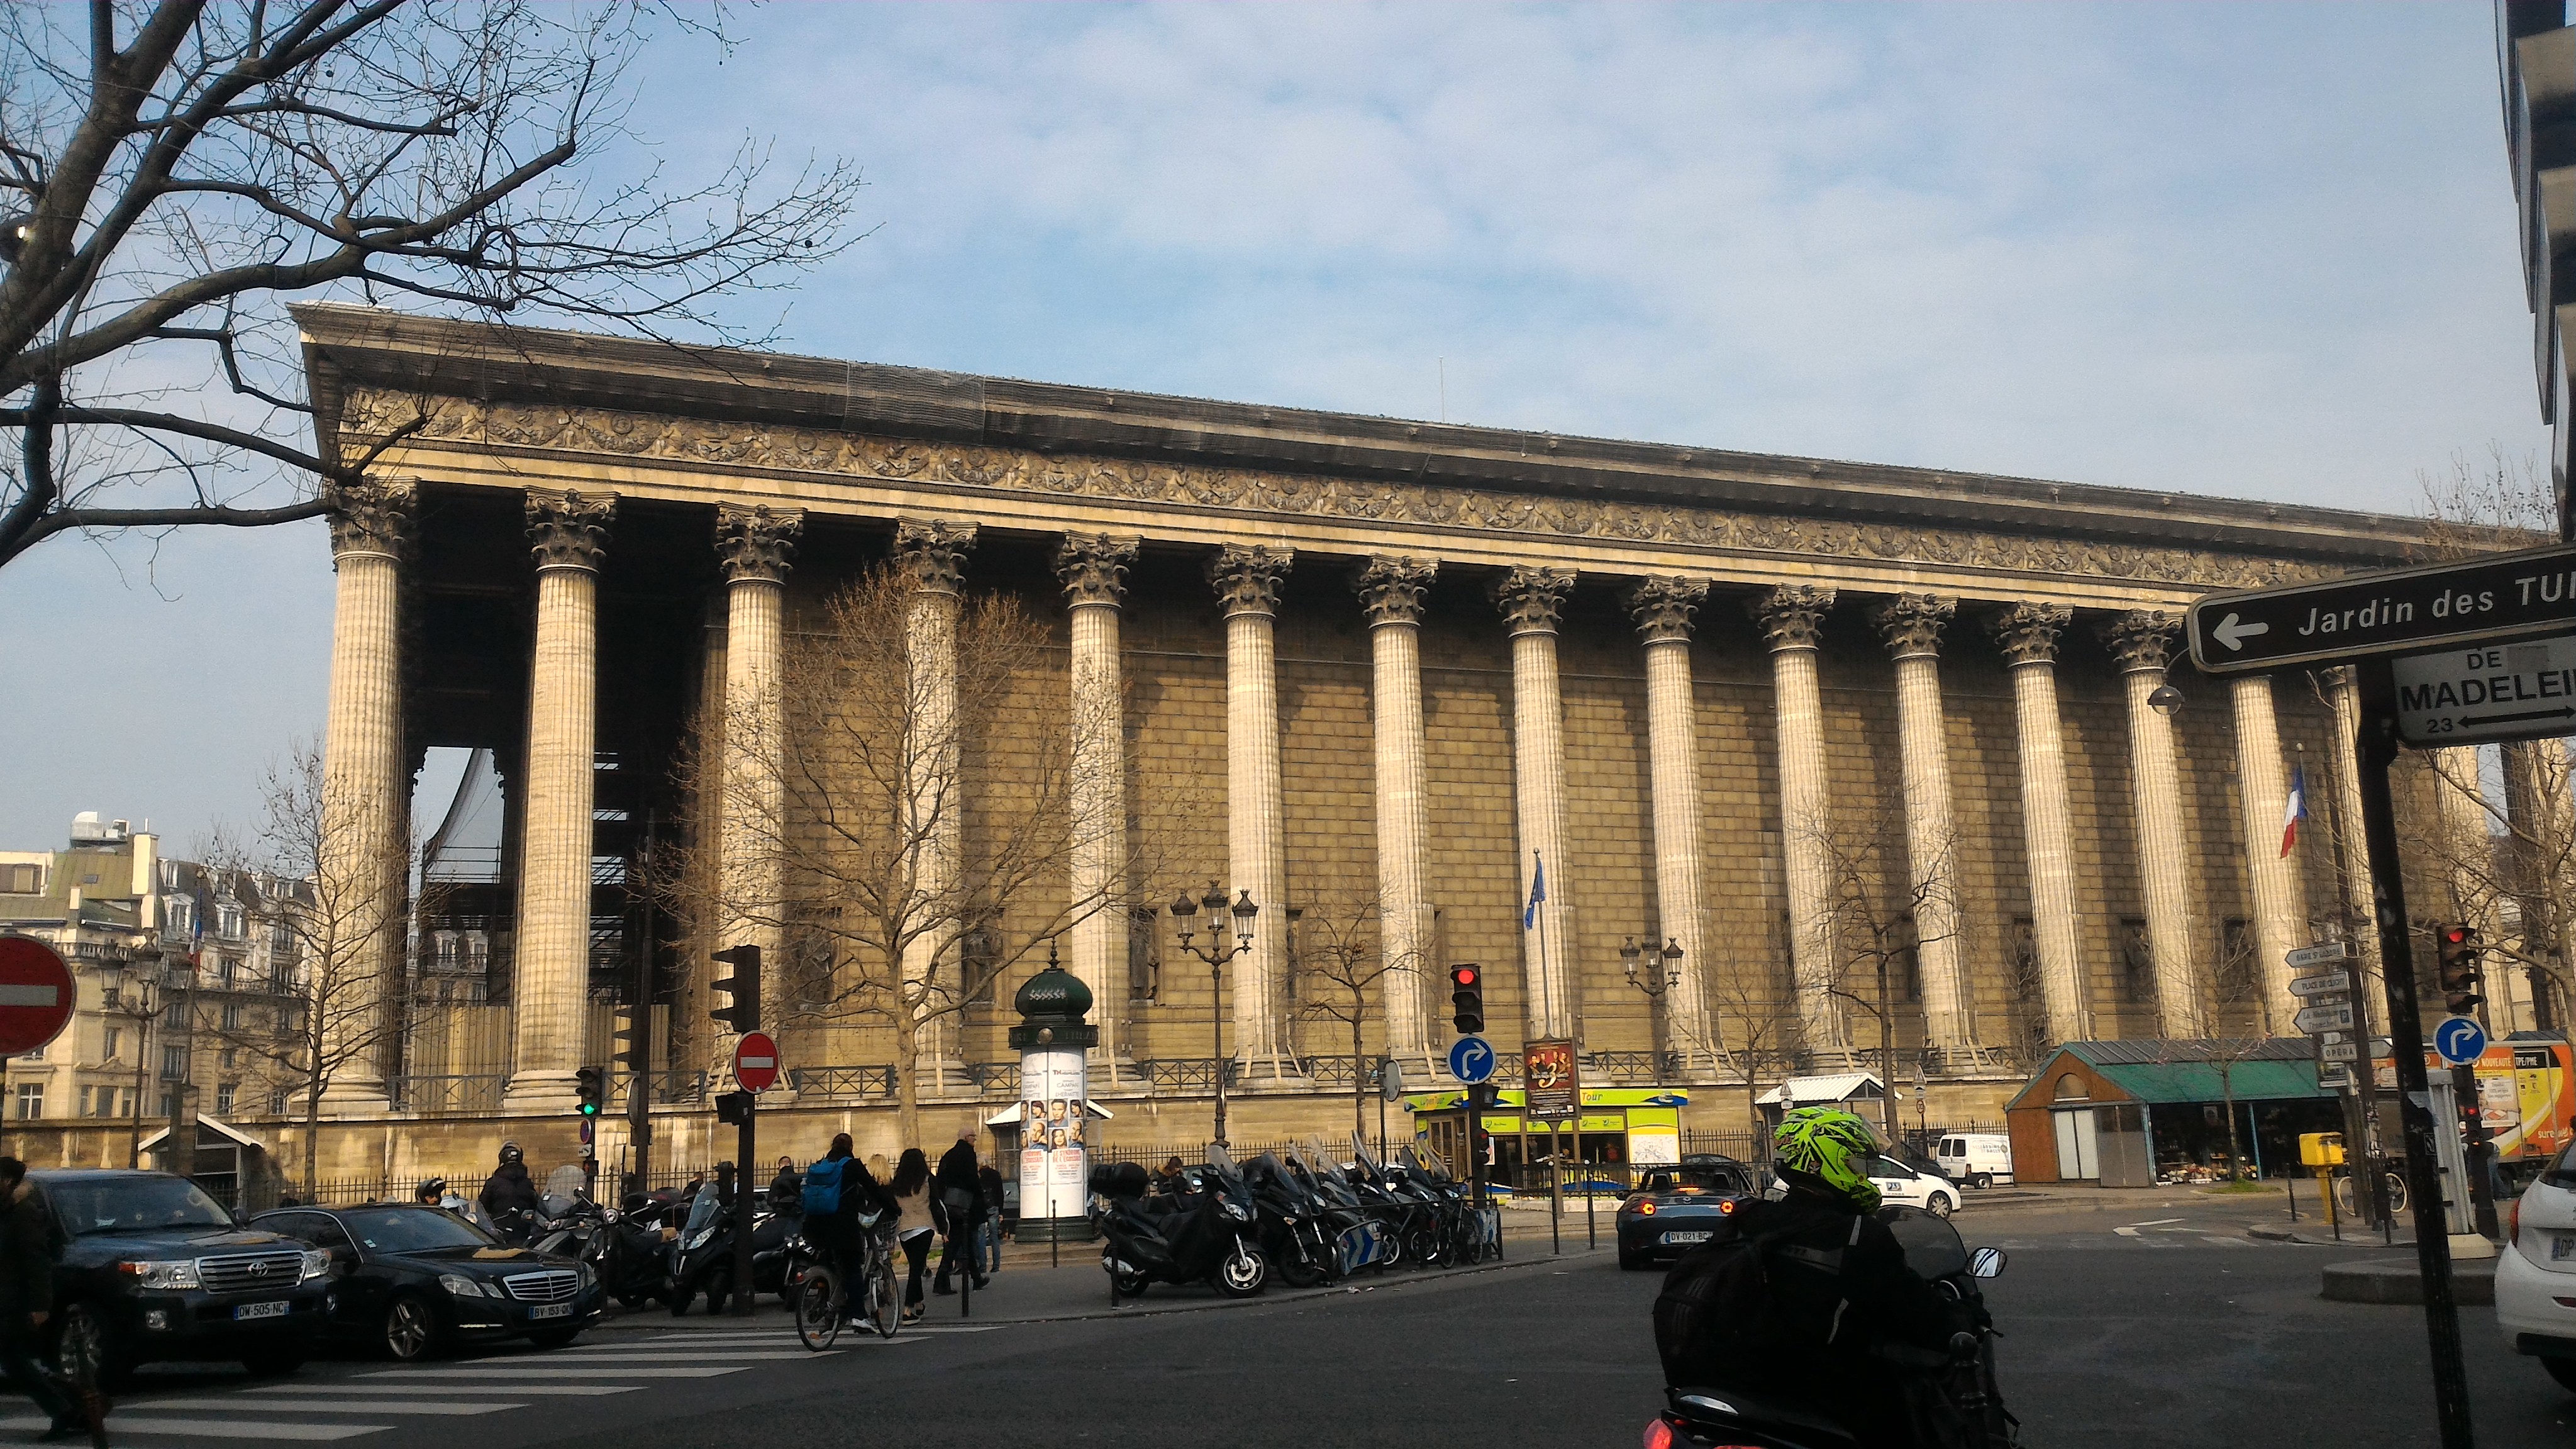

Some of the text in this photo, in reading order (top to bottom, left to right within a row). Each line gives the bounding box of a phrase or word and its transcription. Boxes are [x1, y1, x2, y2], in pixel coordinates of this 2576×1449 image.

[2298, 597, 2413, 636] Jardin
[2431, 589, 2494, 618] des
[2467, 651, 2502, 670] DE
[2400, 669, 2576, 712] MADELEI
[2426, 718, 2453, 734] 23
[2302, 981, 2318, 991] PLACE
[1538, 1062, 1557, 1089] 3
[1582, 1092, 1604, 1101] Tour
[2538, 1130, 2554, 1138] sure
[1671, 1233, 1708, 1241] DV-021-BC
